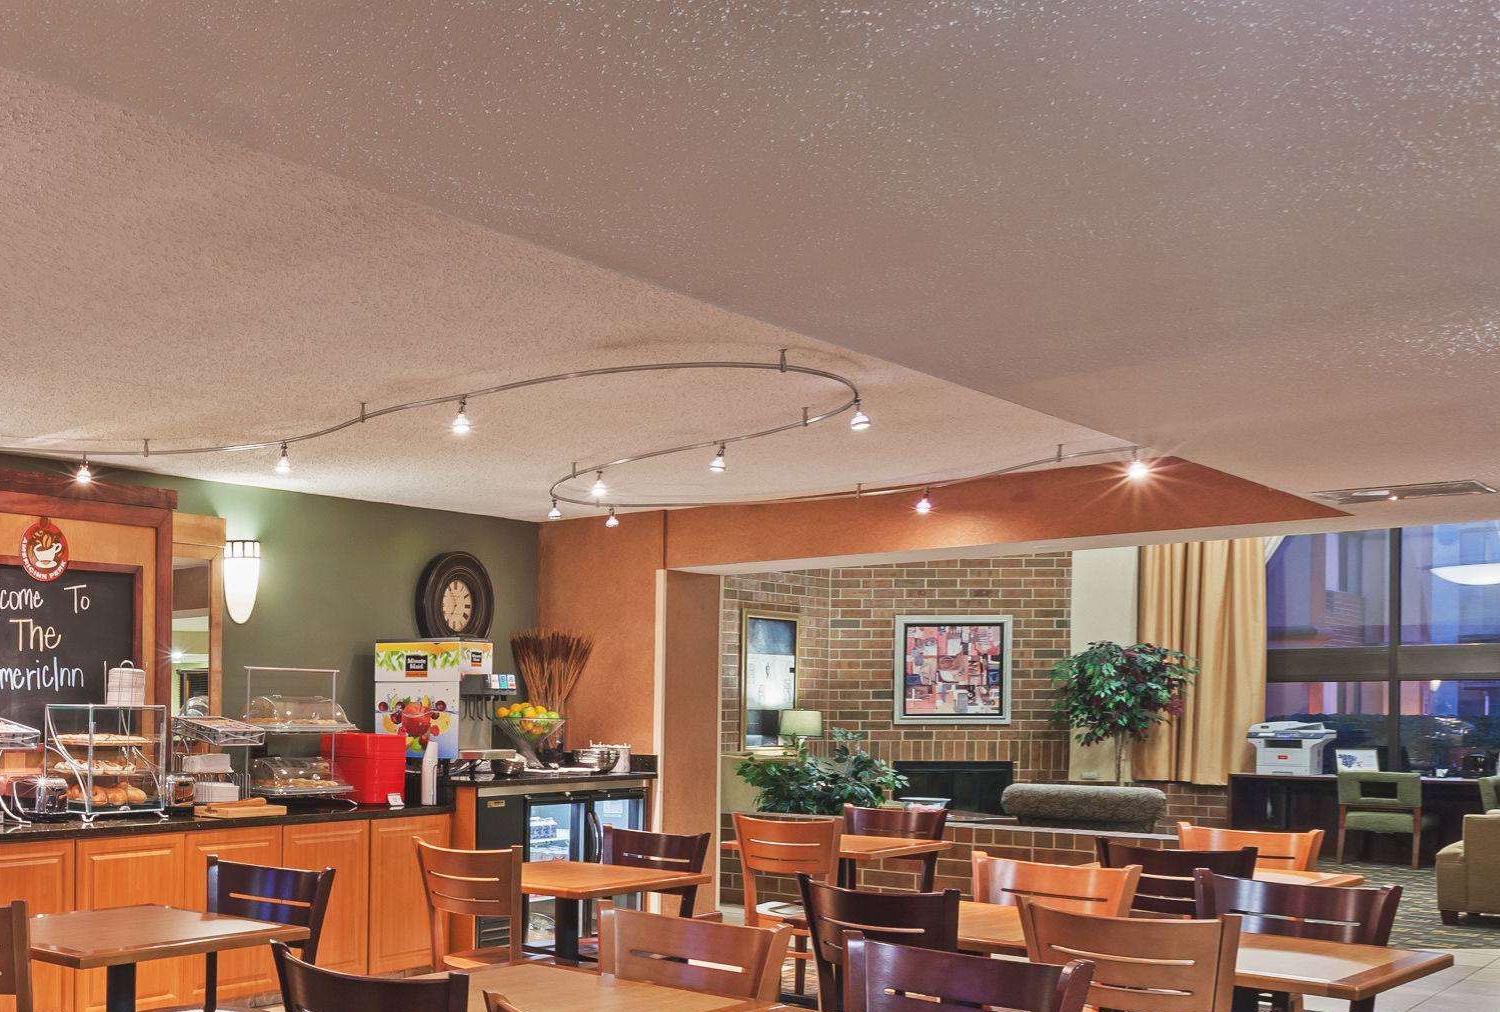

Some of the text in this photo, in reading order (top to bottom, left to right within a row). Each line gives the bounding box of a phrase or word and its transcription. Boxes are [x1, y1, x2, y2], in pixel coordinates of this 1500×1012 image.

[49, 560, 67, 579] PERK
[63, 584, 91, 614] To
[9, 618, 62, 652] The
